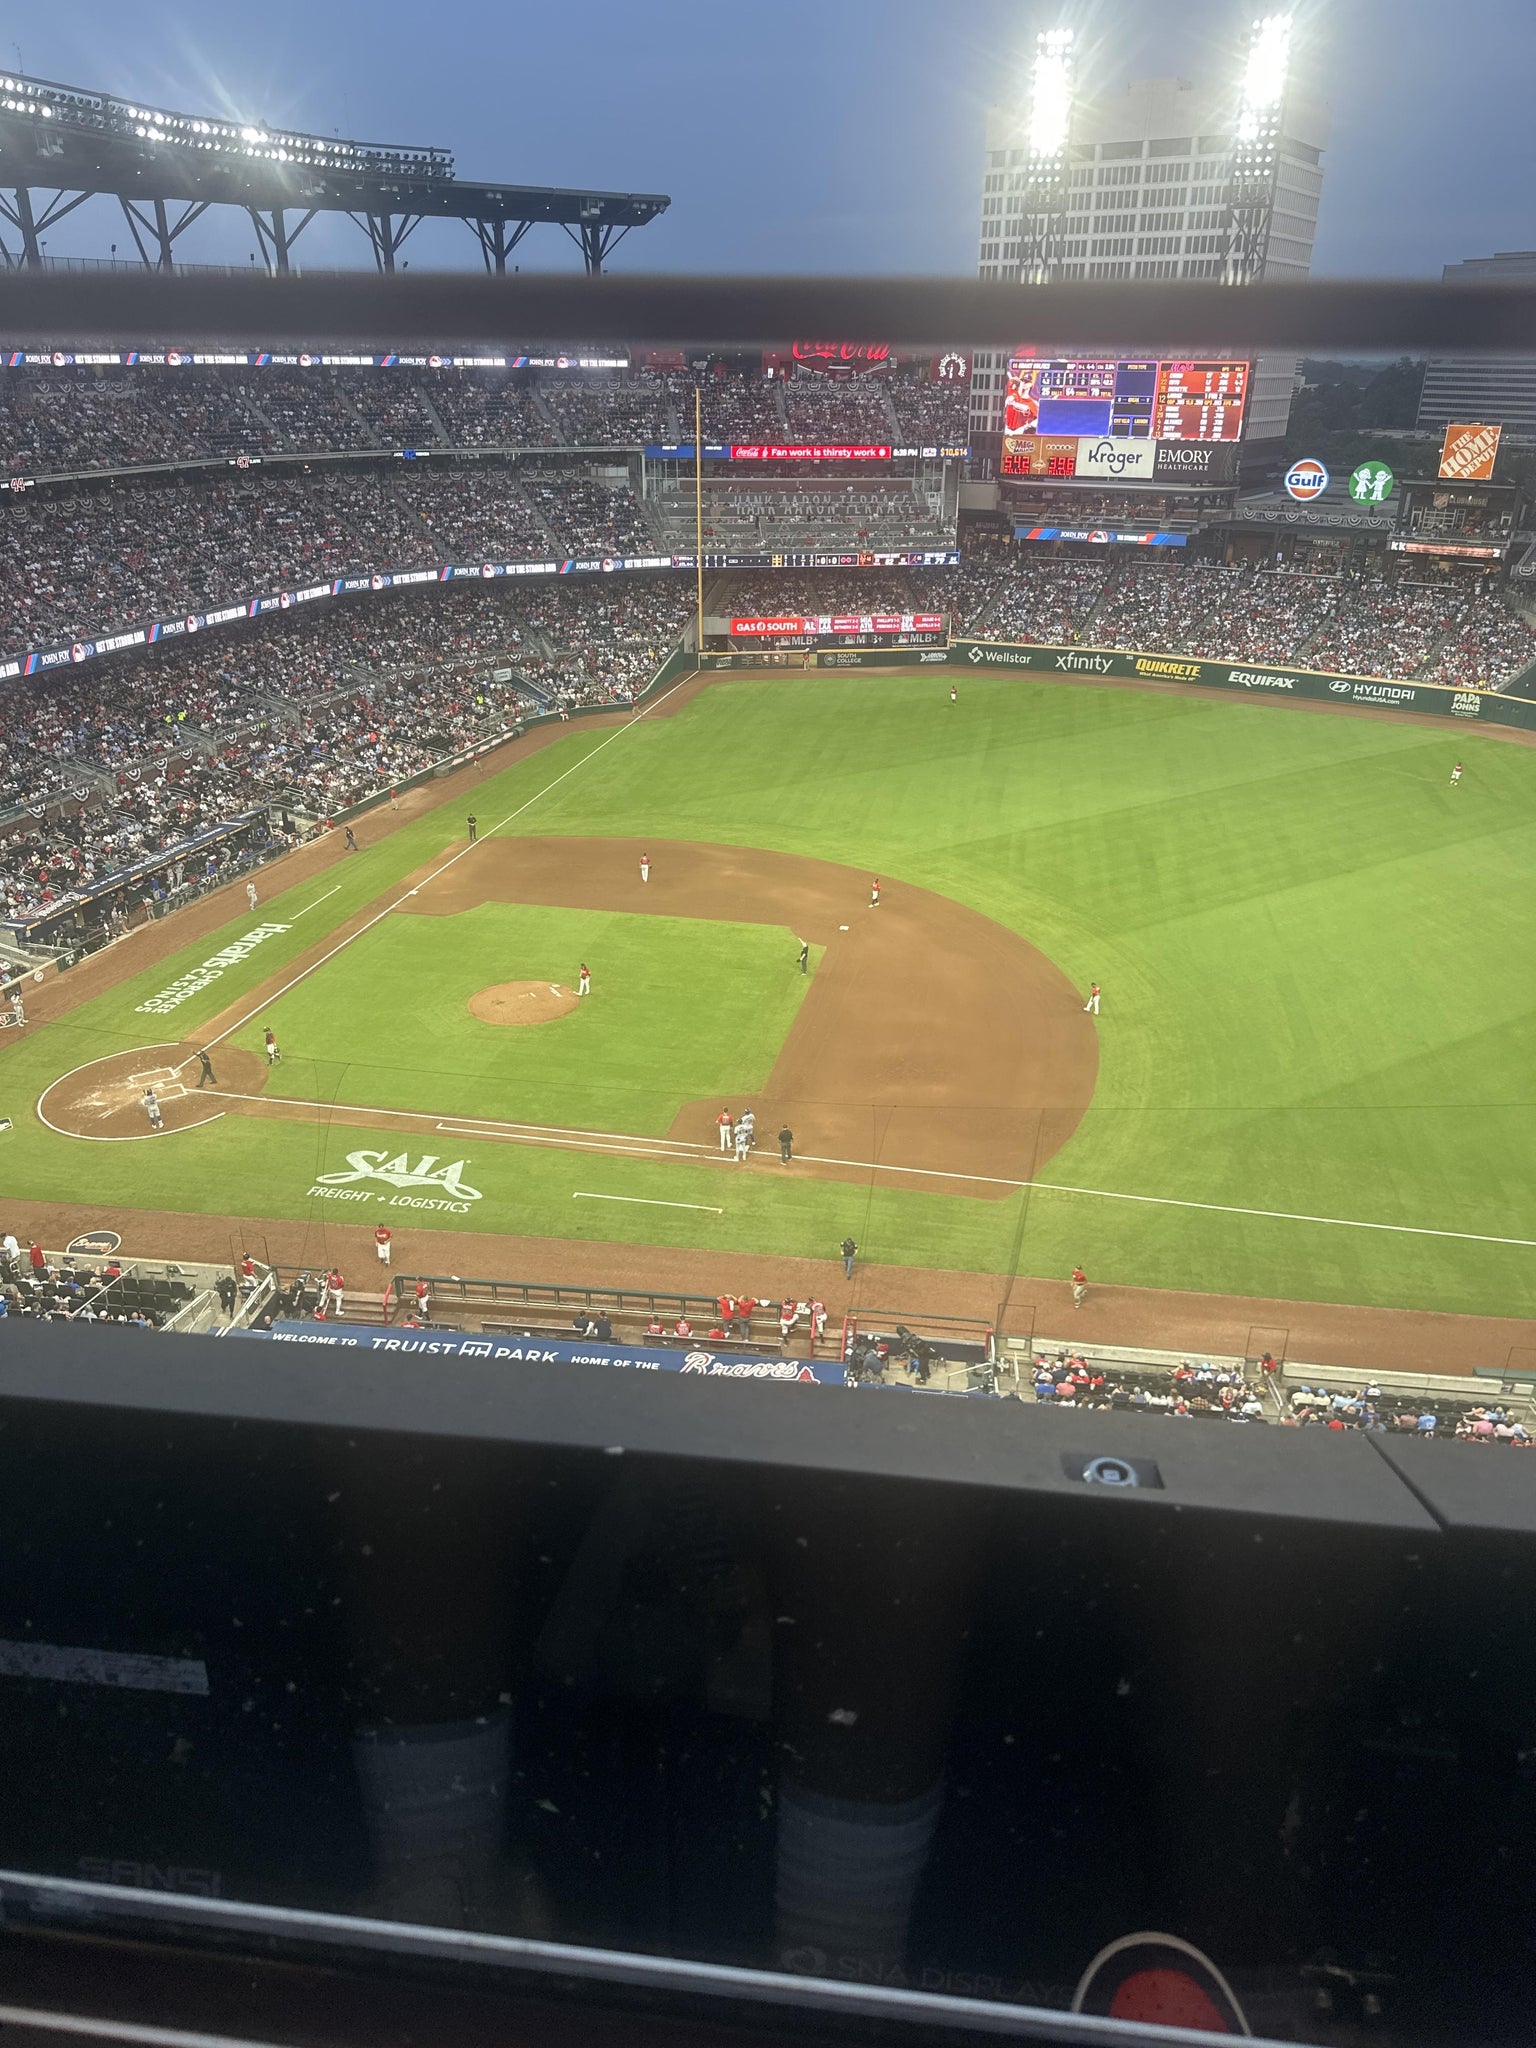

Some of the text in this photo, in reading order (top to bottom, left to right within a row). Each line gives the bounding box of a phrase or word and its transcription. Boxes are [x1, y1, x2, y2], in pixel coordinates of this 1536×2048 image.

[1450, 432, 1473, 452] THE
[823, 449, 852, 458] thirsty
[1088, 442, 1143, 473] Kroger
[1158, 450, 1213, 463] EMORY
[1441, 426, 1498, 477] HOME
[1005, 456, 1030, 468] 542
[1460, 446, 1496, 478] DEPOT
[11, 478, 25, 492] 44
[1288, 474, 1325, 487] Gulf
[734, 494, 915, 515] HANK AARON TERRACE
[162, 624, 175, 634] JOHN
[736, 622, 797, 632] GAS SOUTH
[791, 636, 818, 645] MLB+
[910, 634, 938, 642] MLB+
[42, 653, 58, 665] JOHN
[986, 651, 1032, 664] Wellstar
[1056, 652, 1113, 673] xfinity
[1136, 658, 1201, 676] QUIKRETE
[1228, 671, 1295, 688] EQUIFAX
[1354, 684, 1415, 700] HYUNDAI
[1454, 693, 1480, 704] PAPA
[1353, 695, 1400, 705] HyundaiUSA.com
[1451, 702, 1480, 712] JOHNS
[135, 968, 208, 1013] CASINOS
[152, 970, 224, 1014] CHEROKEE
[316, 1150, 483, 1200] SAIA
[306, 1186, 374, 1202] FREIGHT
[389, 1195, 472, 1214] LOGISTICS
[272, 1333, 338, 1345] WELCOME
[341, 1338, 358, 1346] TO
[372, 1338, 457, 1354] TRUIST
[495, 1348, 559, 1363] PARK
[570, 1356, 610, 1366] HOME
[635, 1361, 660, 1370] THE
[680, 1352, 800, 1378] Braves
